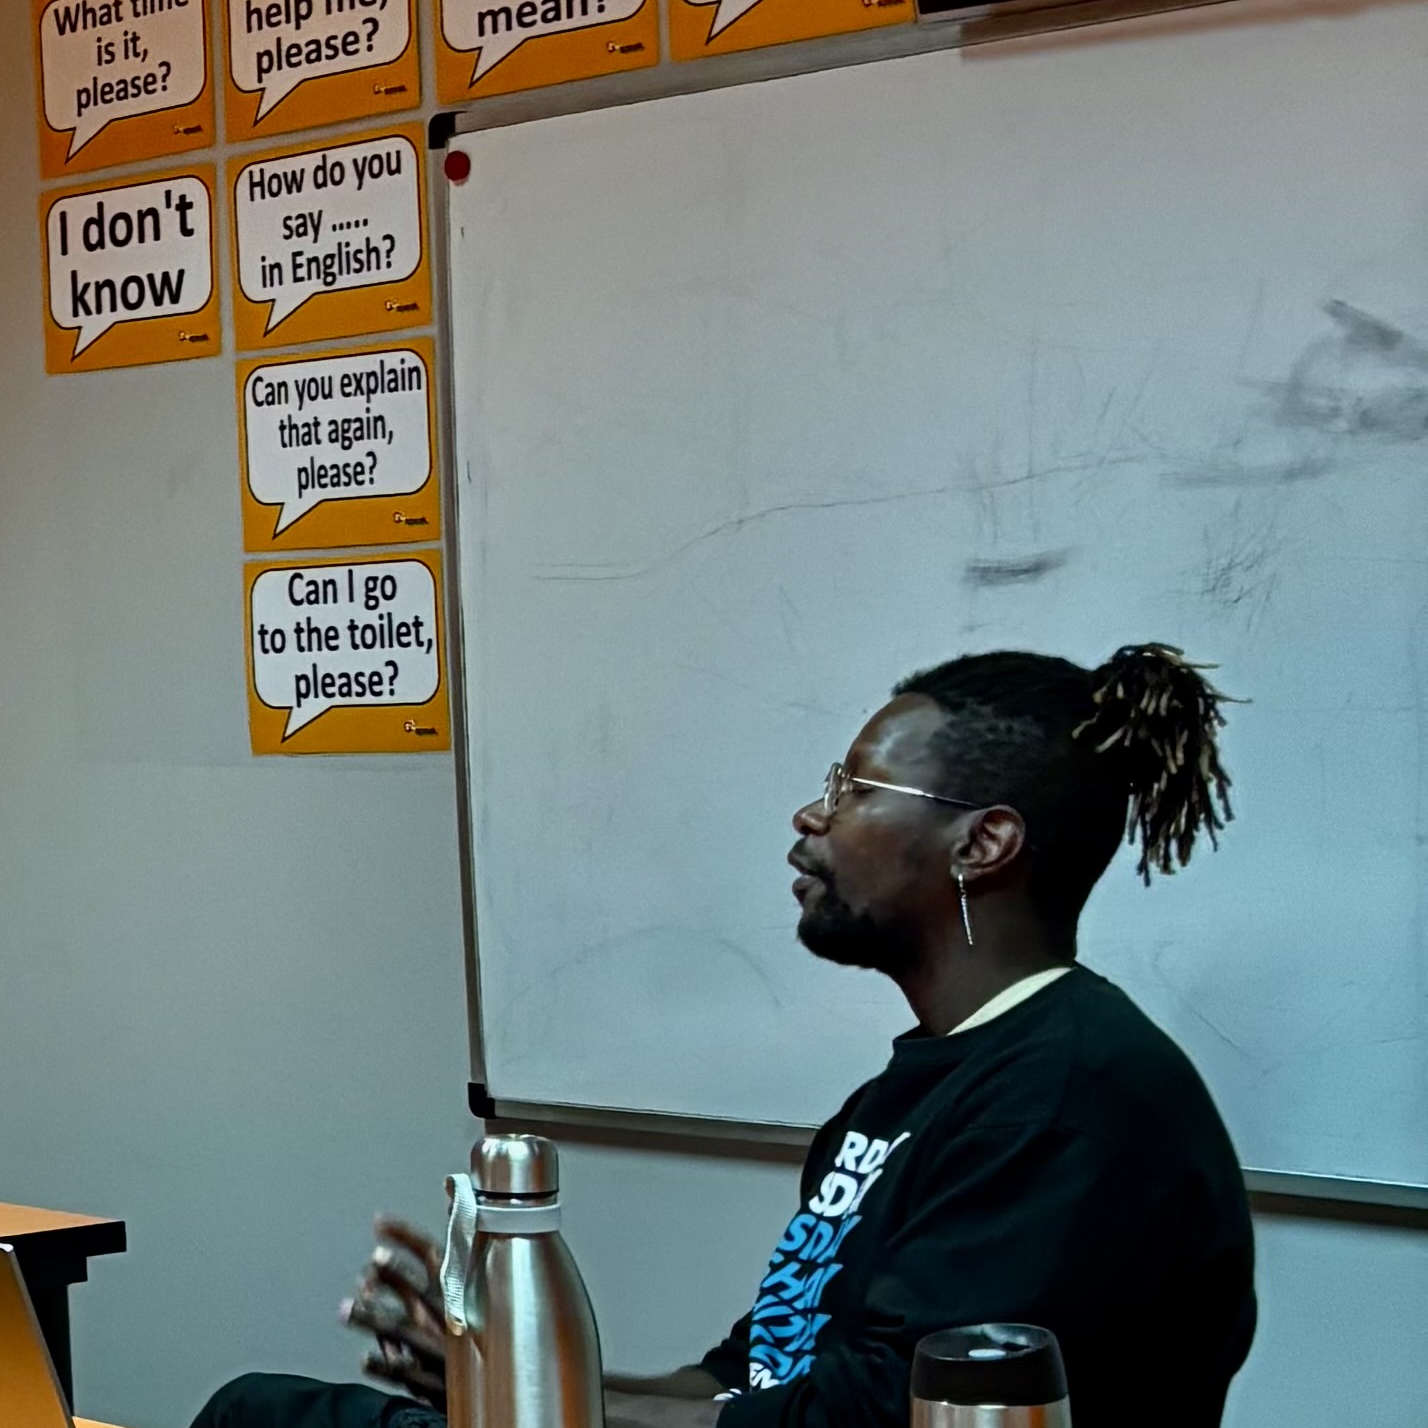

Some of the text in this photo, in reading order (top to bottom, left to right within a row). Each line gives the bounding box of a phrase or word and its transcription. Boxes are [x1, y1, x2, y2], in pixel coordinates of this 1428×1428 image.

[96, 29, 149, 67] is it,
[256, 16, 380, 85] please?
[76, 60, 172, 118] please?
[248, 149, 402, 202] How do you
[59, 189, 195, 257] I don't
[282, 209, 324, 244] say
[260, 233, 396, 289] in English?
[70, 268, 186, 319] know
[251, 357, 422, 411] Can you explain
[278, 406, 394, 451] that again,
[297, 450, 378, 499] please?
[288, 568, 398, 611] Can I go
[257, 611, 433, 655] to the toilet,
[294, 659, 399, 709] please?
